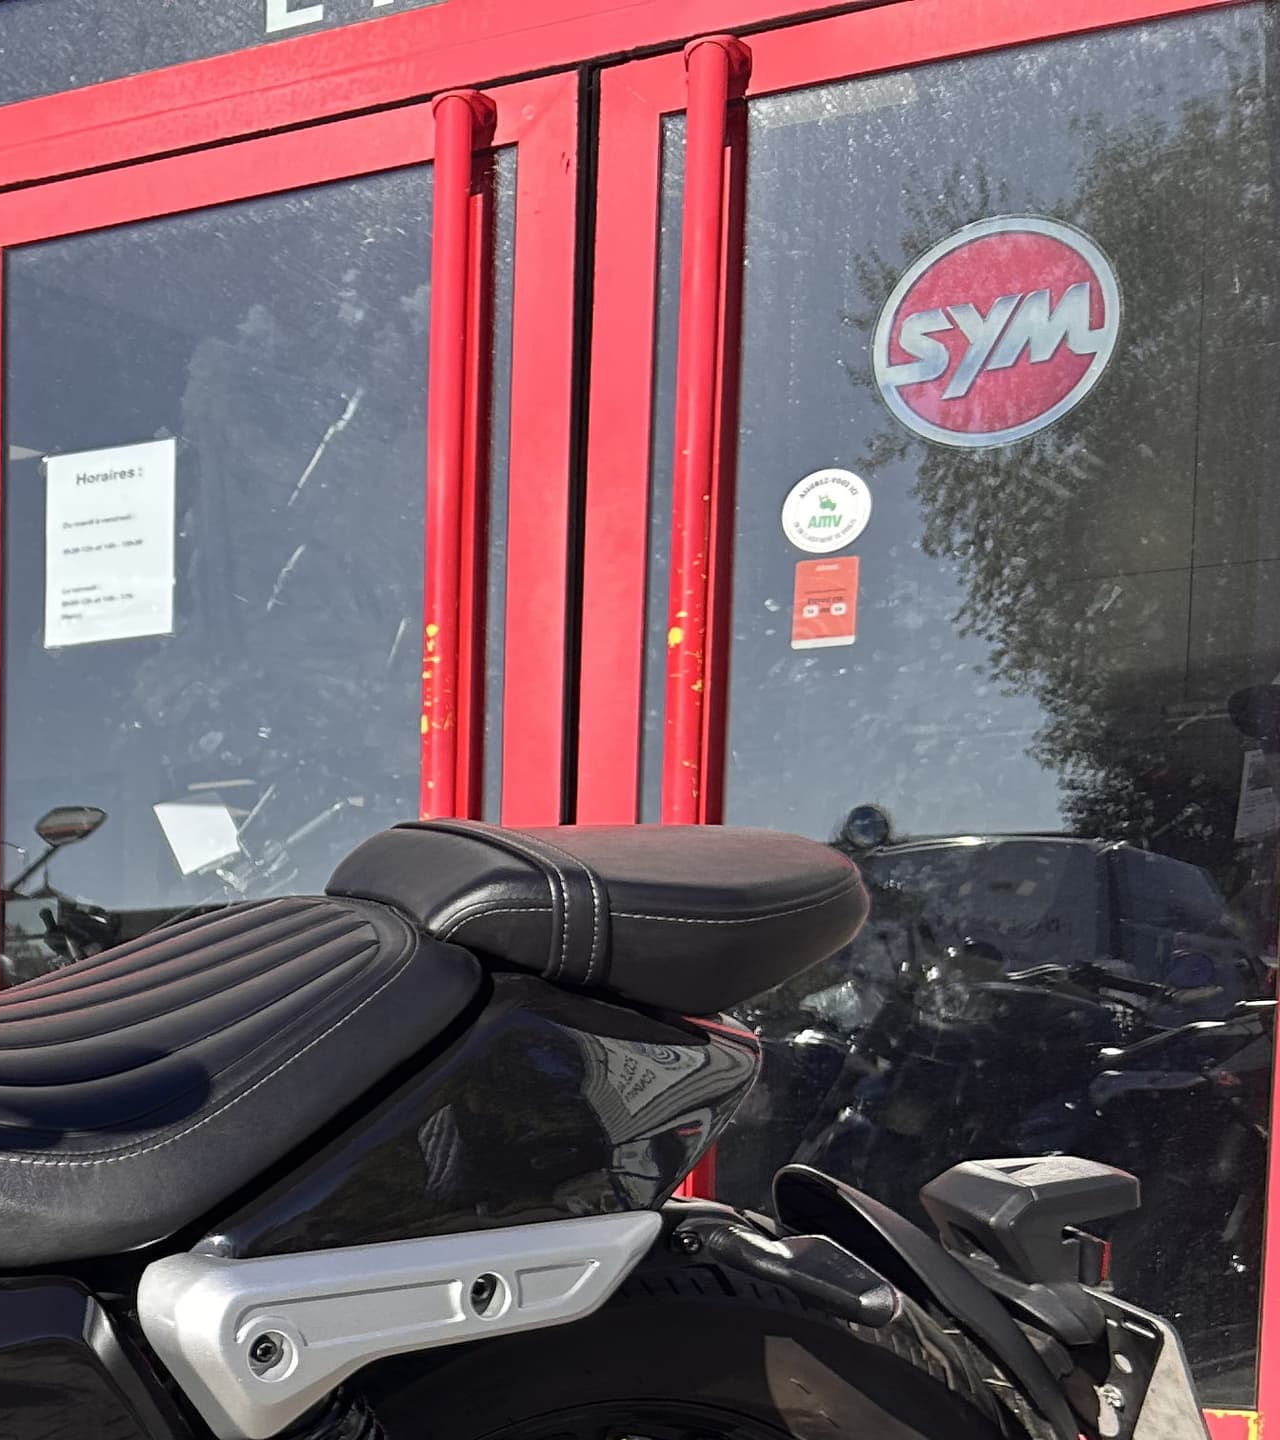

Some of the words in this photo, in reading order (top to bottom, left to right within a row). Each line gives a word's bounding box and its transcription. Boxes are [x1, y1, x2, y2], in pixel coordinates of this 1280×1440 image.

[880, 281, 1112, 400] SYM
[76, 467, 135, 486] Horaires
[807, 514, 843, 529] AMV
